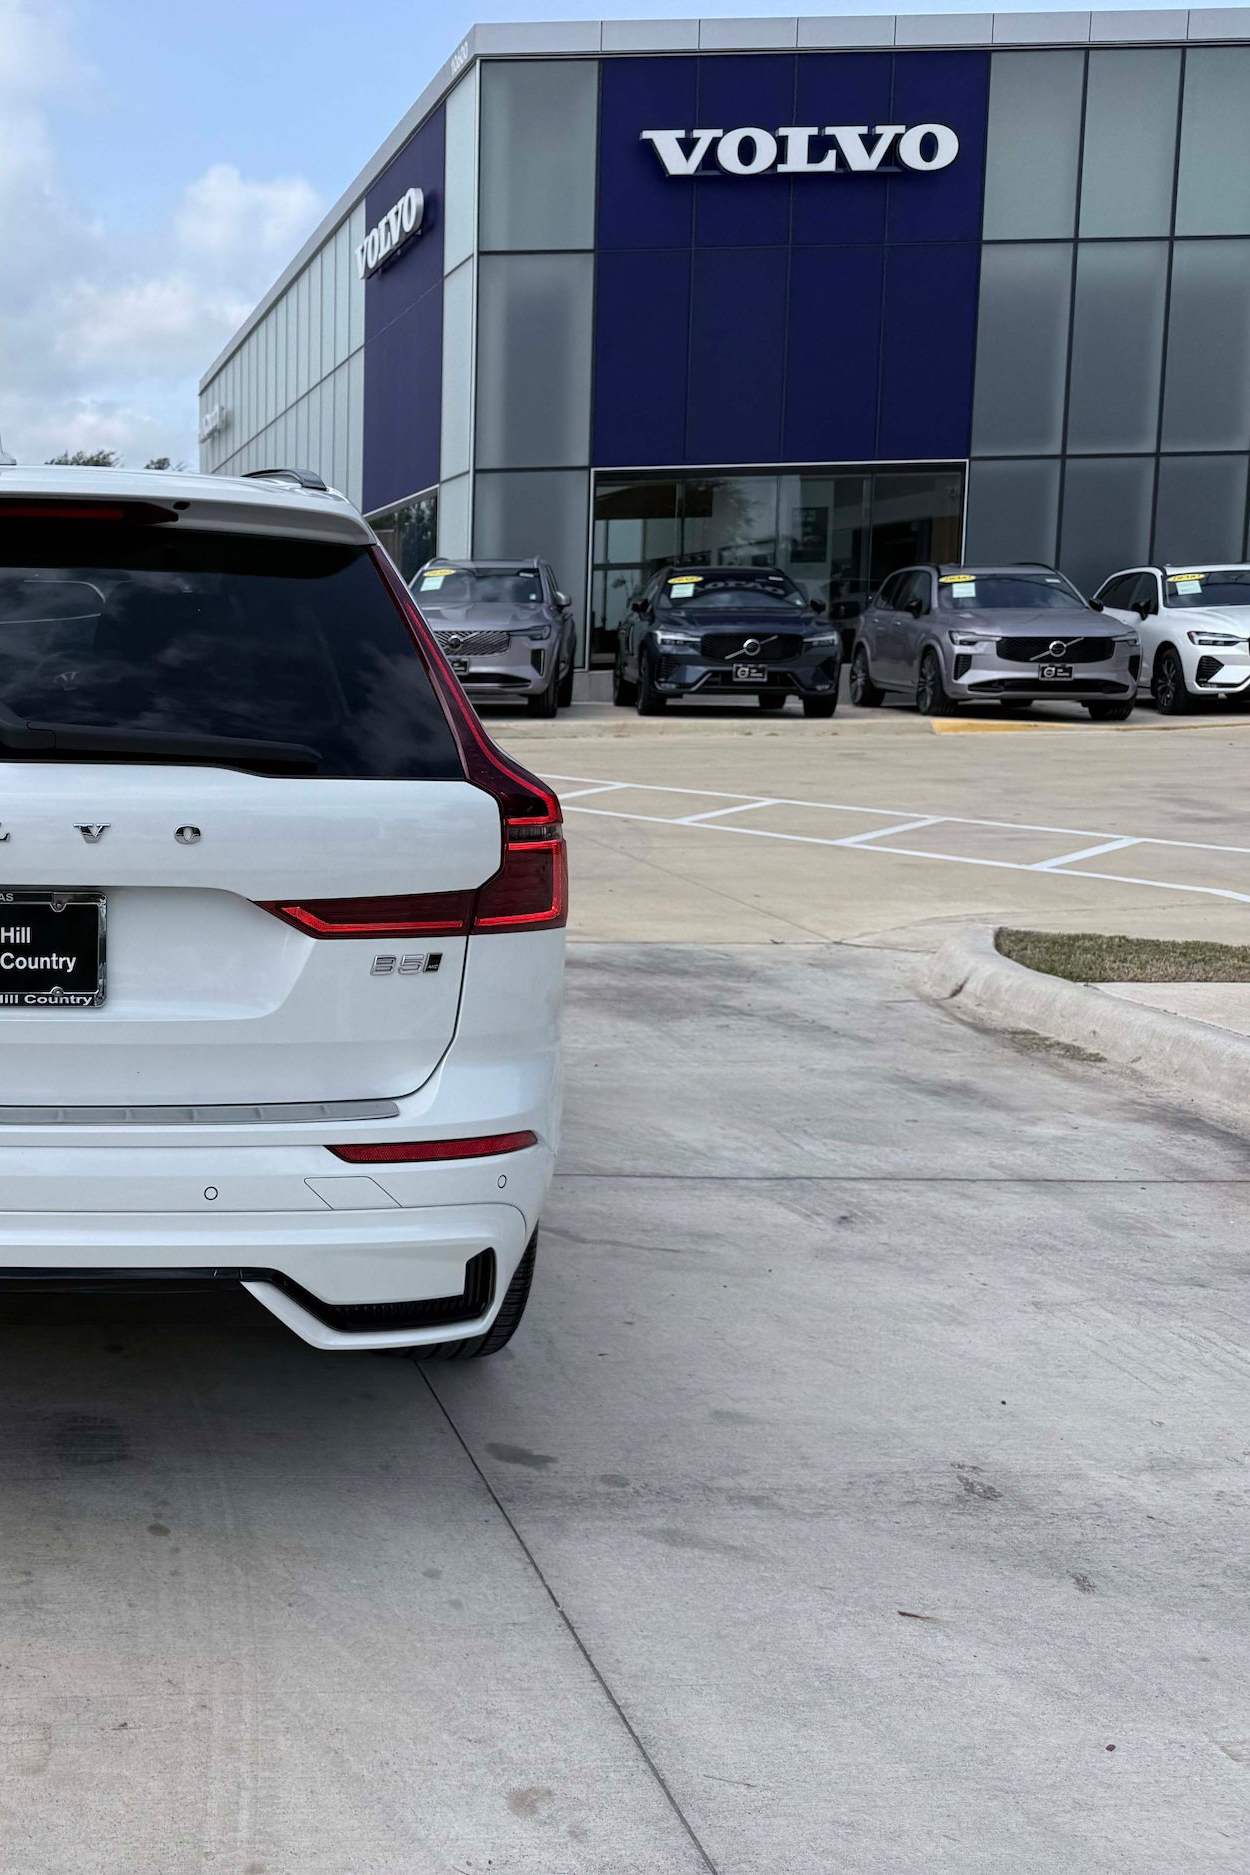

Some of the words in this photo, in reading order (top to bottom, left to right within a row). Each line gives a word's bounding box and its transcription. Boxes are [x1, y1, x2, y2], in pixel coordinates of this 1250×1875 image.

[640, 123, 959, 176] VOLVO
[355, 187, 424, 280] VOLVO
[0, 926, 31, 944] Hill
[0, 952, 77, 973] Country
[370, 954, 425, 976] B5
[24, 994, 92, 1006] Country
